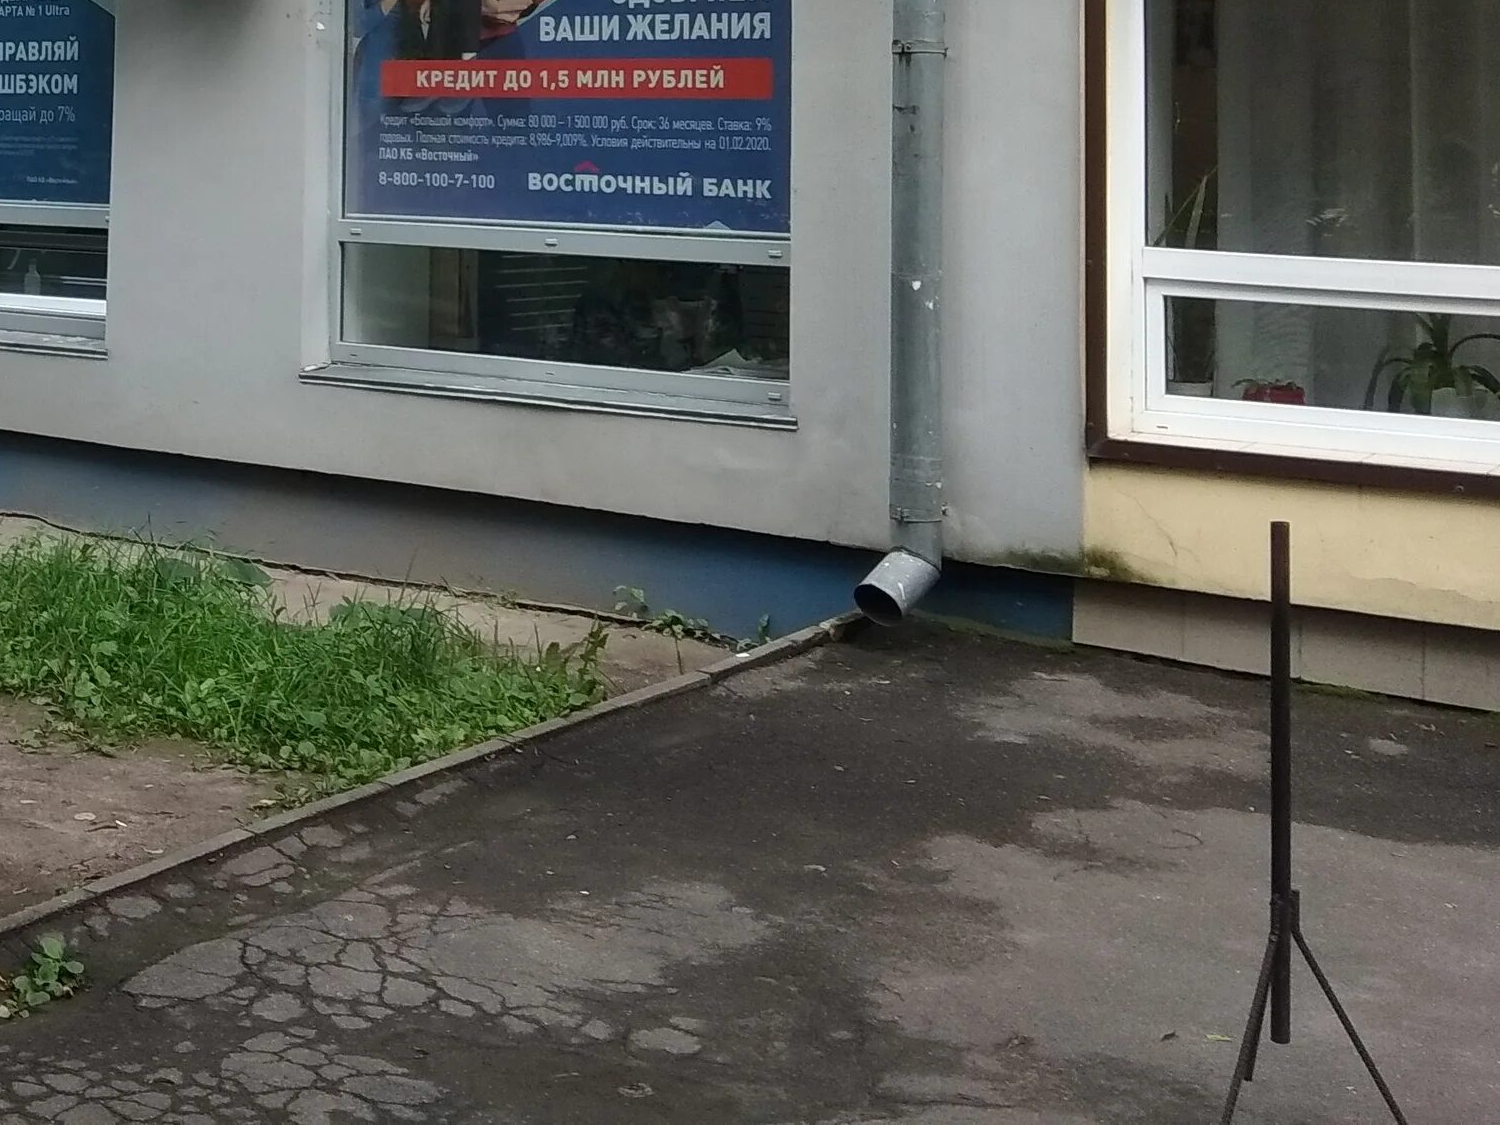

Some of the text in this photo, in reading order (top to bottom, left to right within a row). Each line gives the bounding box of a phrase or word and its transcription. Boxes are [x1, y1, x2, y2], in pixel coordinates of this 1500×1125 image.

[45, 5, 70, 17] Ultra
[539, 12, 771, 42] ВАШИ ЖЕЛАНИЯ
[416, 64, 725, 91] КРЕДИТ ДО 1,5 МЛН РУБЛЕЙ
[39, 108, 54, 124] до
[58, 106, 76, 122] 7%
[658, 116, 670, 129] 36
[672, 119, 714, 132] месяцев.
[717, 117, 752, 131] Ставка:
[755, 117, 772, 131] 9%
[631, 136, 700, 150] действительны
[704, 139, 716, 149] на
[379, 148, 397, 160] ПАО
[400, 148, 413, 160] КБ
[378, 172, 495, 189] 8-800-100-7-100
[702, 177, 772, 199] БАНК
